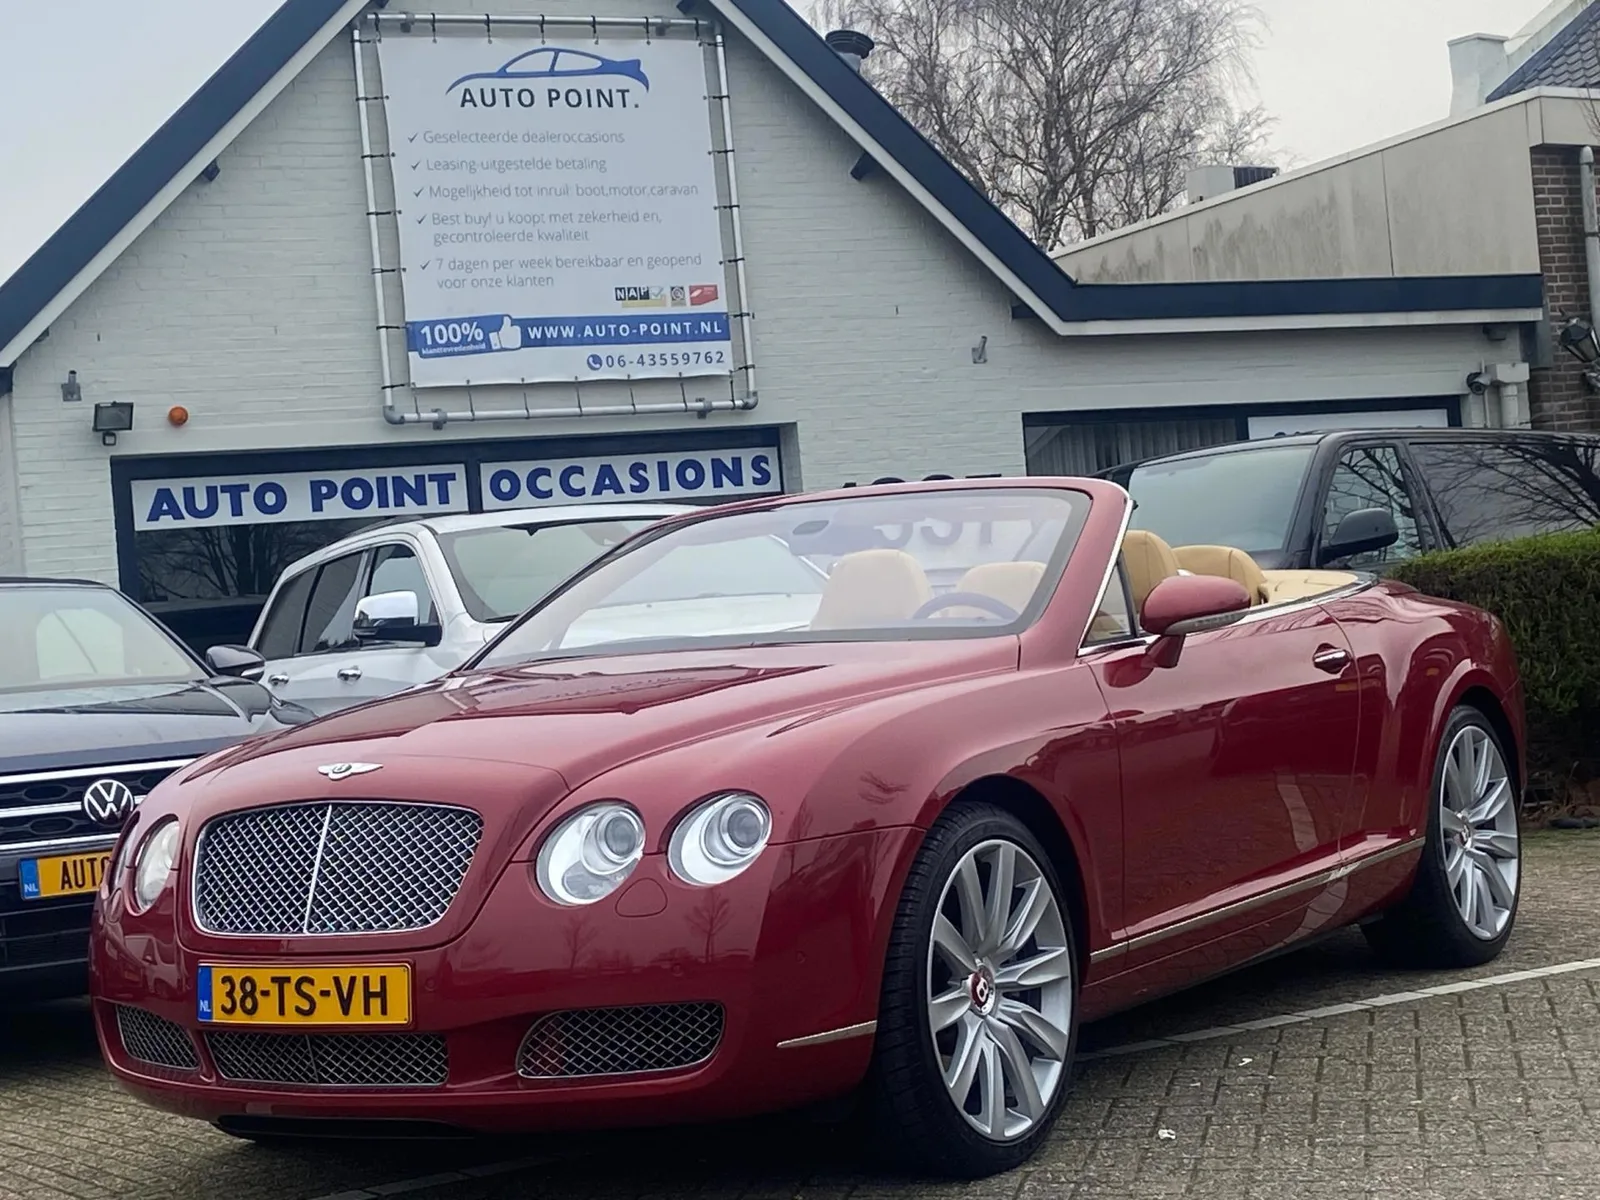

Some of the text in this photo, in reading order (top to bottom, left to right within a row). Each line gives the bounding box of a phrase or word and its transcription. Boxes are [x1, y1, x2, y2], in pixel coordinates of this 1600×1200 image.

[460, 87, 535, 108] AUTO
[422, 130, 625, 144] Geselecteerde dealeroccasions
[556, 157, 607, 174] betaling
[428, 183, 511, 201] Mogelijkheid
[515, 186, 532, 197] tot
[432, 210, 663, 228] Best buy! u koopt met zekerheid en,
[434, 229, 588, 248] gecontroleerde kwaliteit
[436, 253, 702, 274] 7 dagen per week bereikbaar en geopend
[437, 275, 554, 289] voor onze klanten
[616, 286, 649, 301] NAP
[420, 322, 484, 345] 100%
[528, 320, 722, 340] WWW.AUTO-POINT.NL
[605, 350, 725, 369] 06-43559762
[489, 454, 772, 501] OCCASIONS
[146, 472, 457, 522] AUTO POINT
[24, 883, 38, 892] NL
[220, 974, 388, 1016] 38-TS-VH
[199, 1000, 212, 1012] NL
